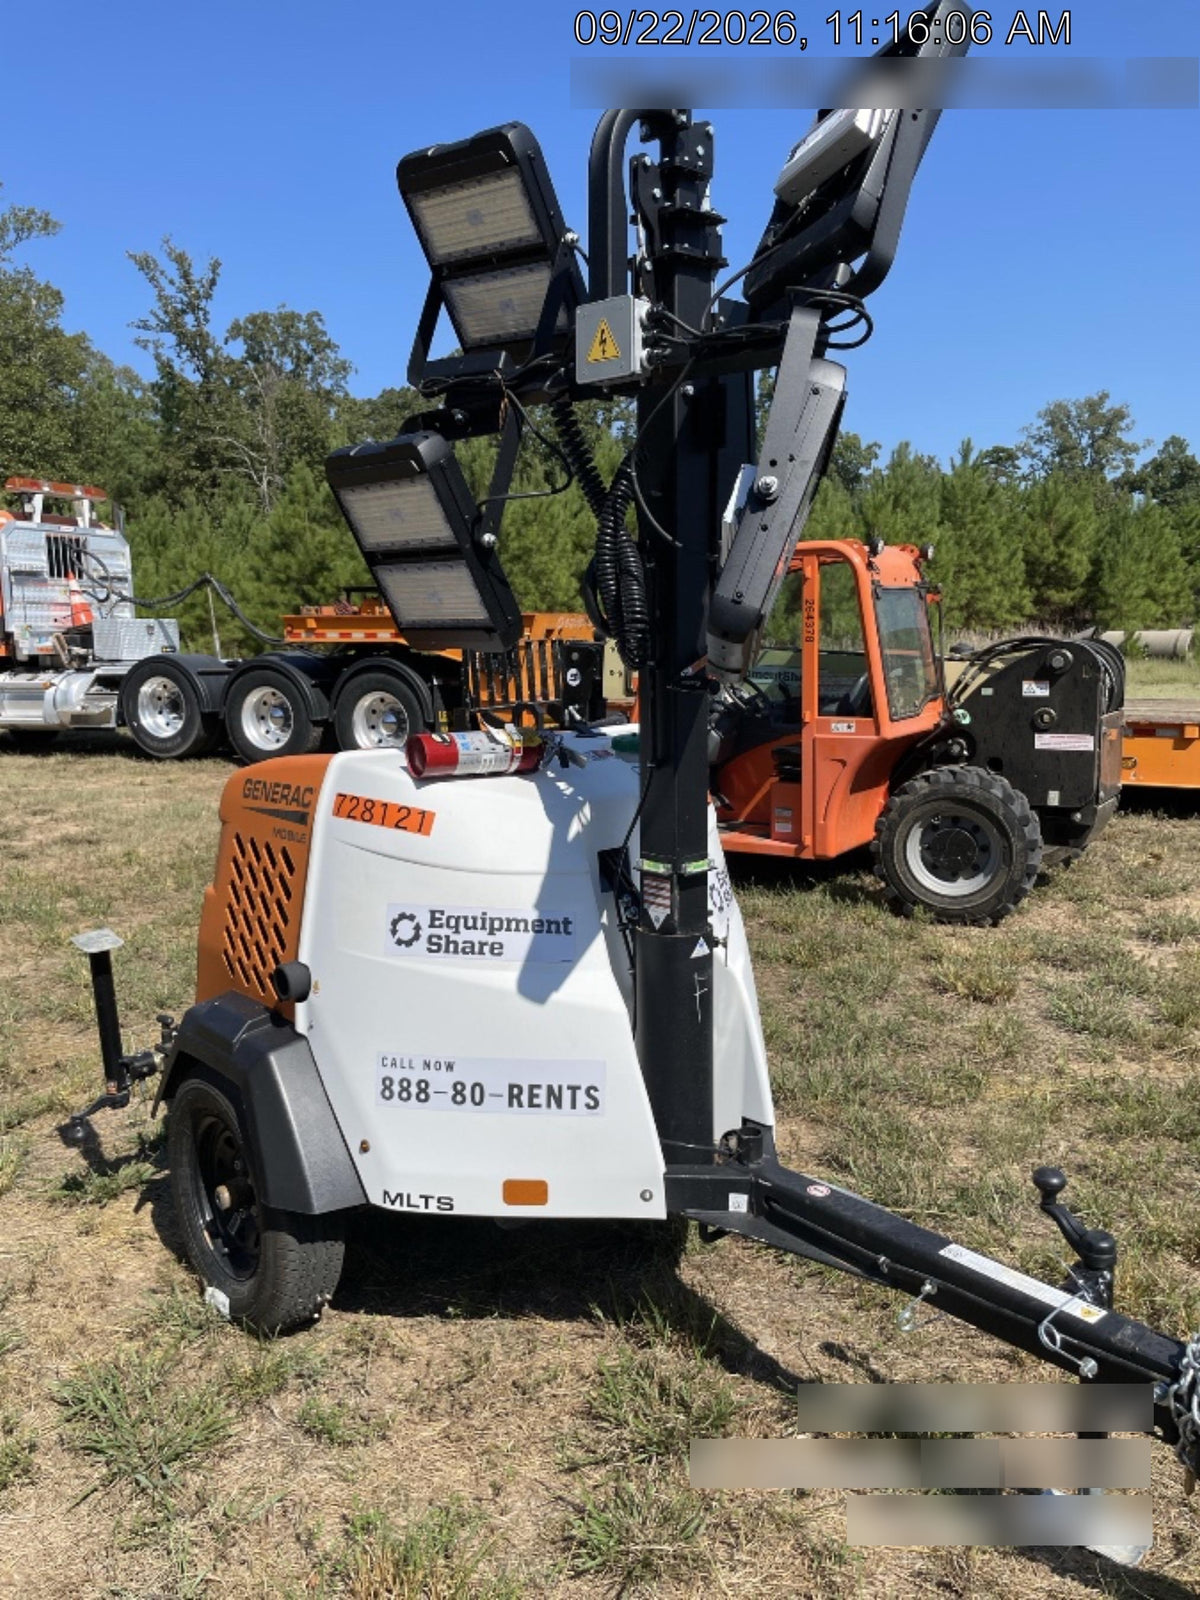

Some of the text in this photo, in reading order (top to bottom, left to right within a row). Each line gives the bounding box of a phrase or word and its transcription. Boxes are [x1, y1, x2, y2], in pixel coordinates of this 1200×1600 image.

[242, 778, 314, 809] GENERAC
[334, 793, 427, 833] 728121
[428, 909, 573, 936] Equipment
[426, 934, 504, 957] Share
[381, 1056, 456, 1073] CALL NOW
[380, 1076, 601, 1111] 888-80-RENTS
[382, 1189, 455, 1212] MLTS
